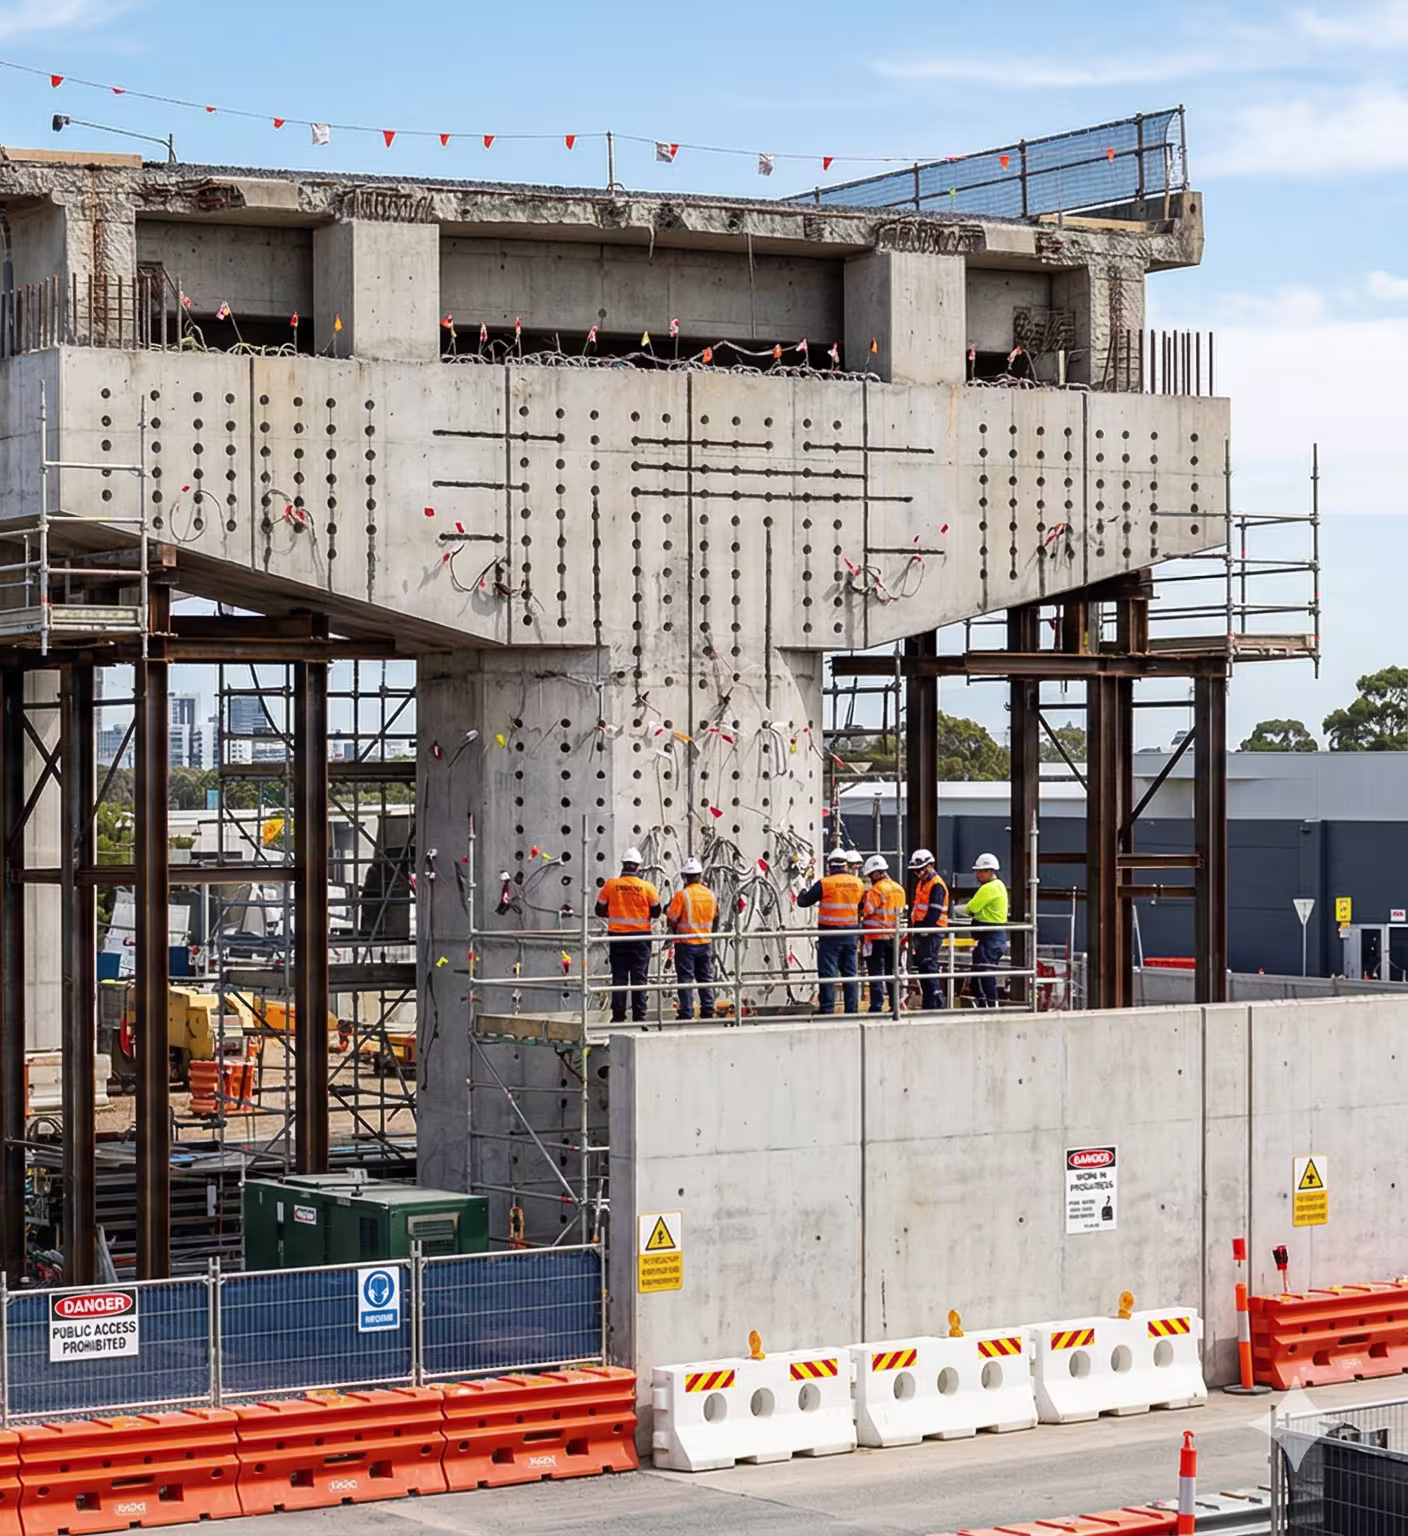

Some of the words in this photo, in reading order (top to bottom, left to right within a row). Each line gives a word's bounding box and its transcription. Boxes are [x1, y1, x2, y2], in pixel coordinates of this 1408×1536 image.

[64, 1297, 125, 1314] DANGER
[53, 1325, 91, 1339] PUBLIC
[94, 1321, 136, 1336] ACCESS
